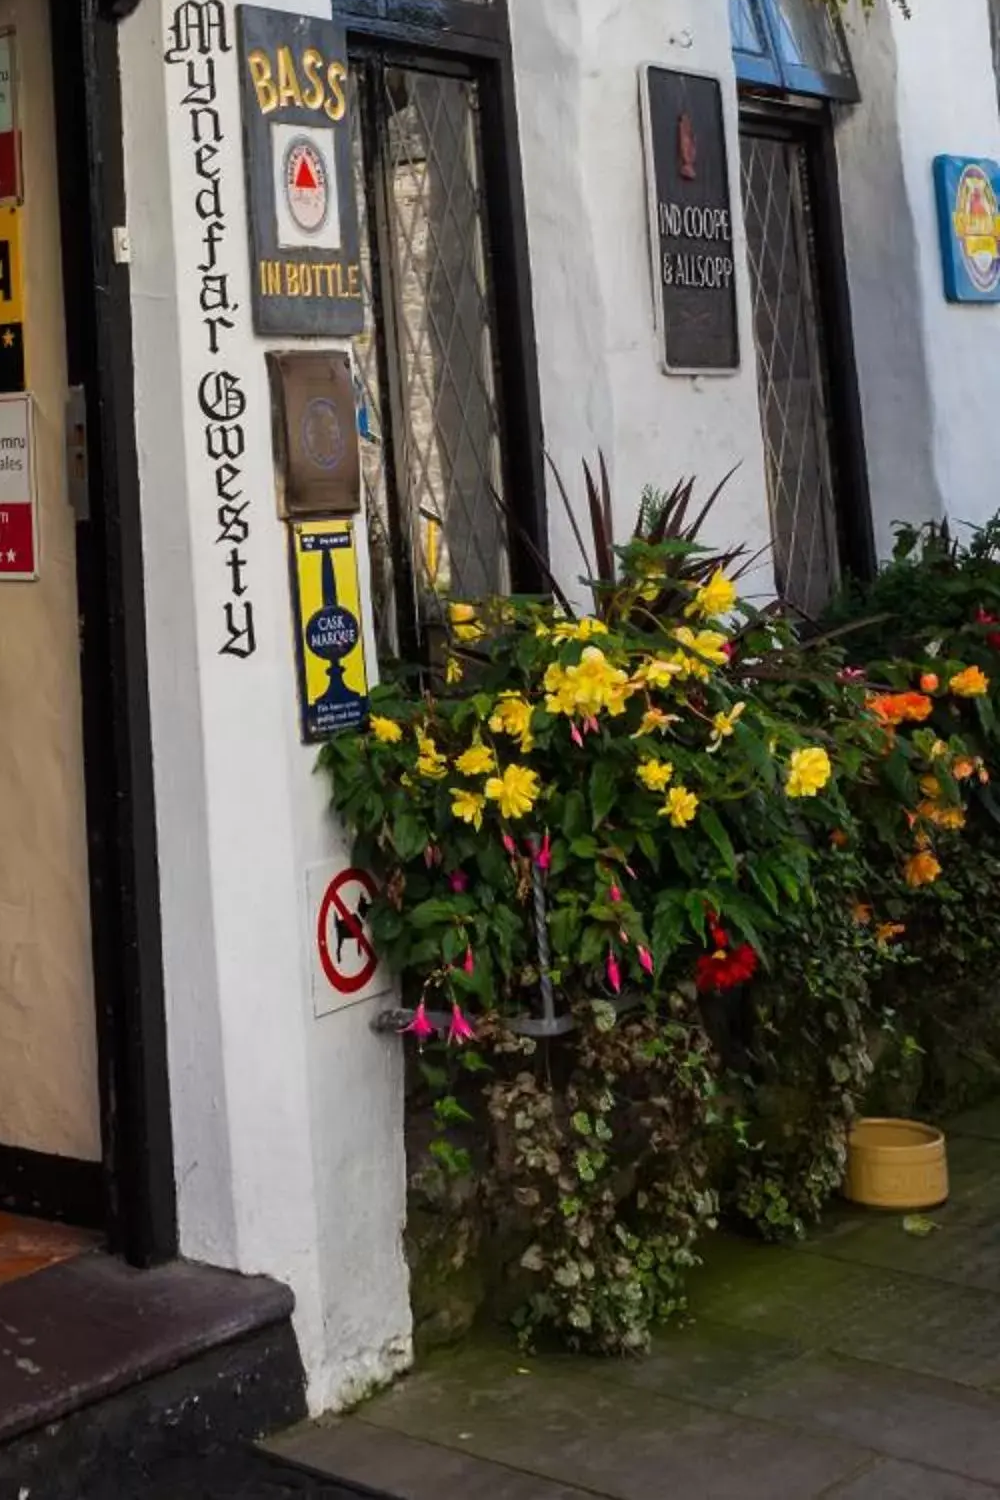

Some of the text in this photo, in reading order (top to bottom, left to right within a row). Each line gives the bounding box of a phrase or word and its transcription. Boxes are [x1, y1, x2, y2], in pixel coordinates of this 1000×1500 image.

[247, 44, 348, 122] BASS
[683, 204, 731, 242] COOPE
[259, 260, 362, 299] IN BOTTLE
[675, 253, 734, 290] ALLSOPP
[197, 370, 257, 660] Gwesty
[310, 629, 356, 647] MARQUE
[316, 614, 346, 631] CASK
